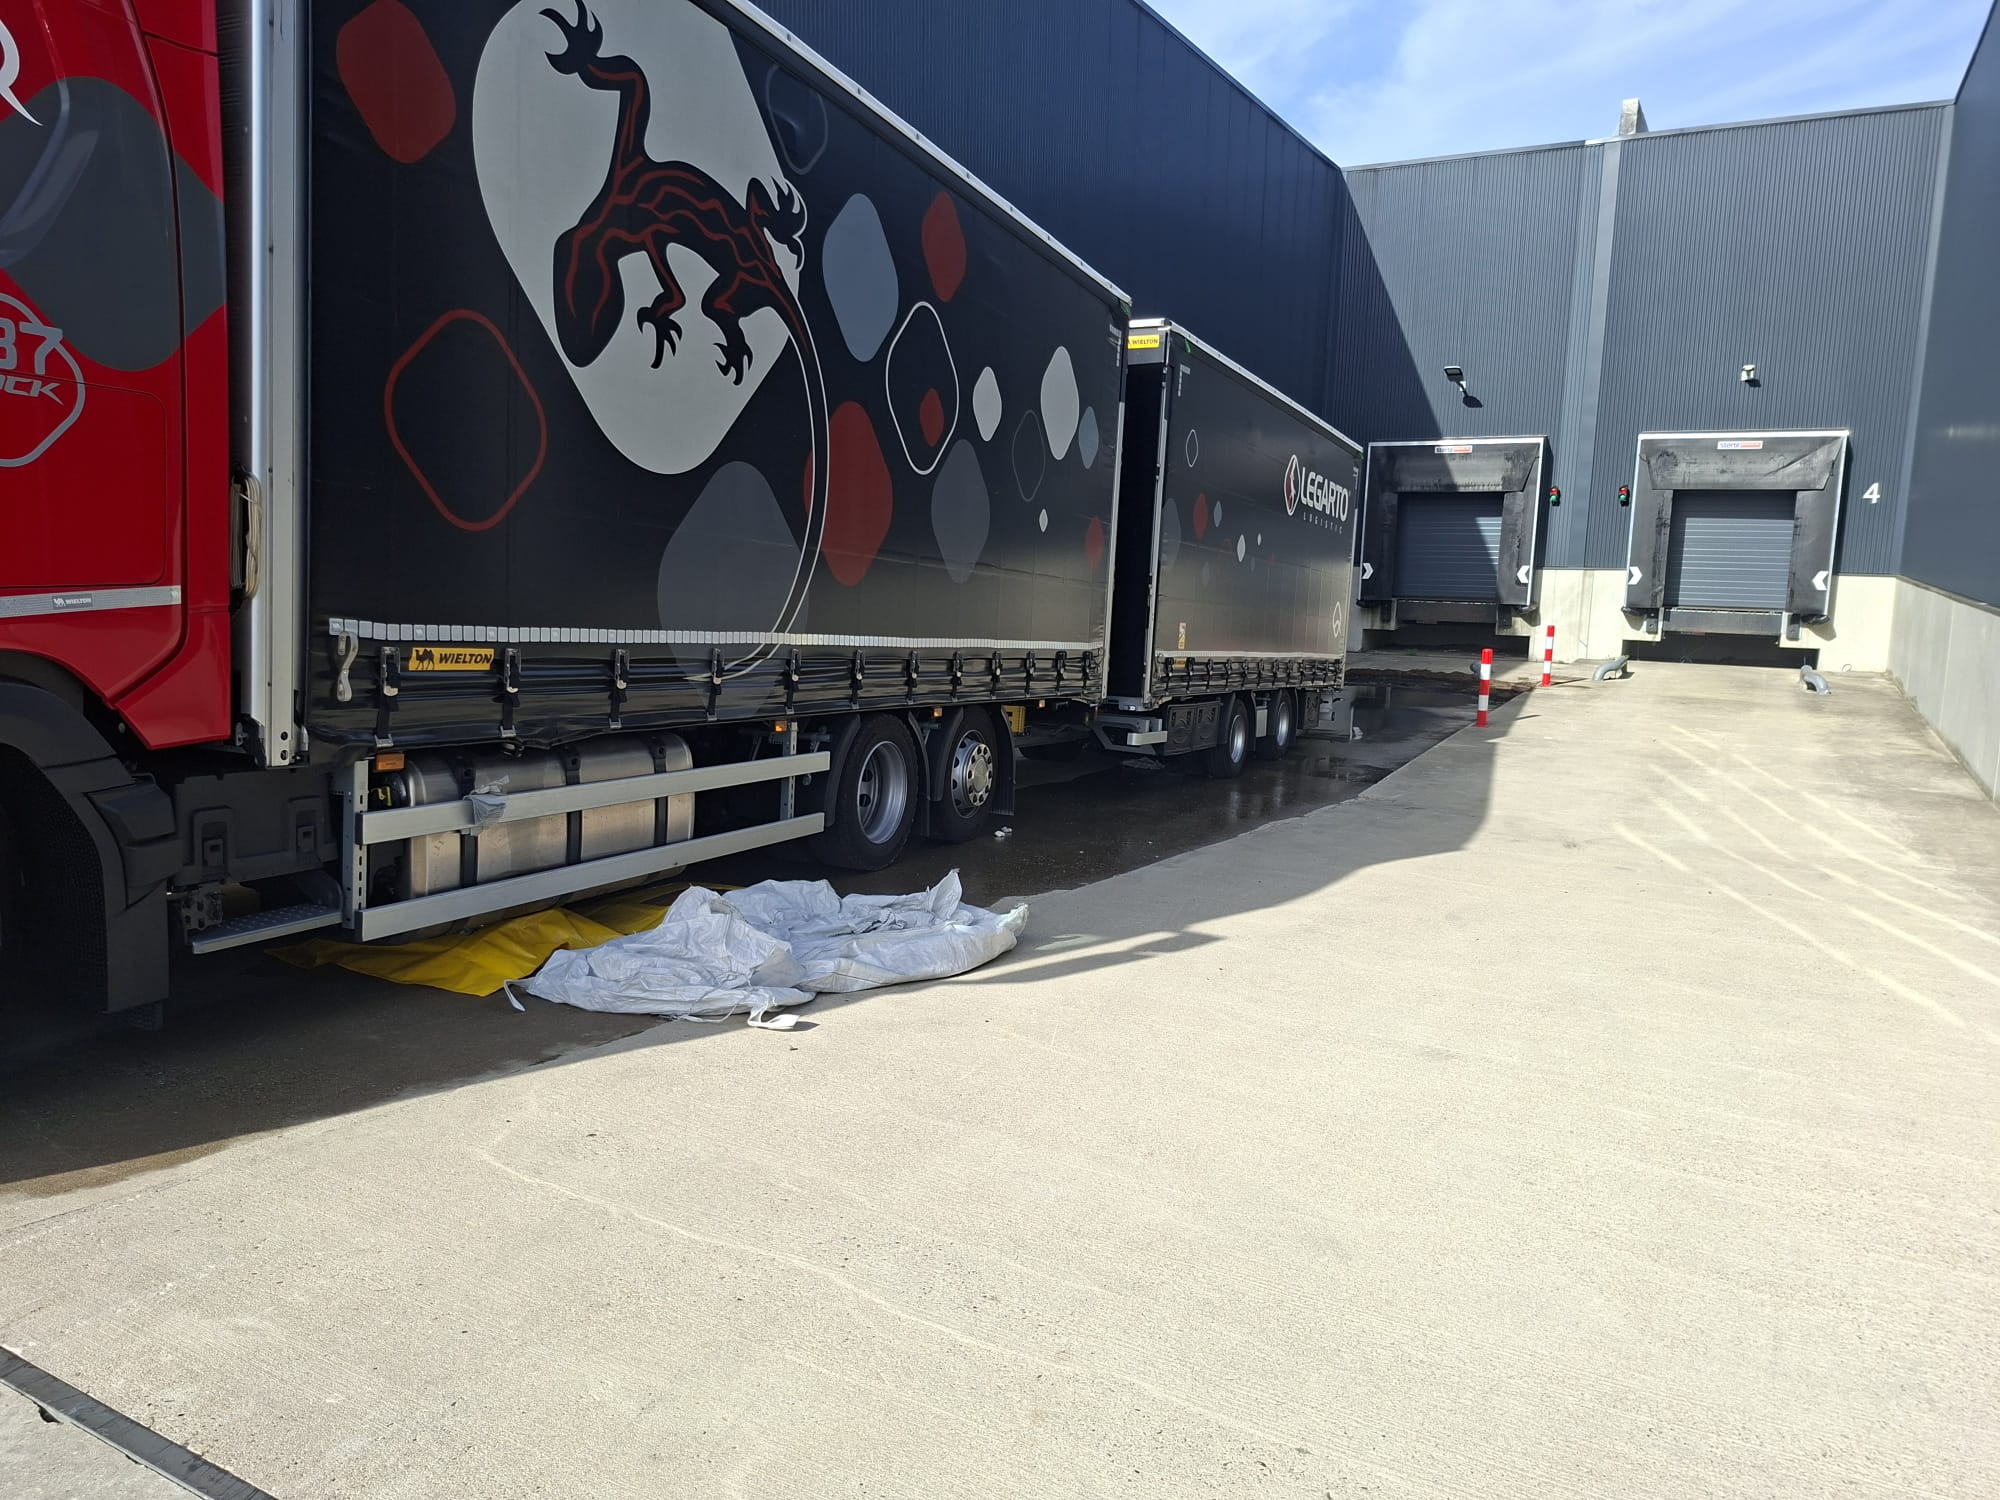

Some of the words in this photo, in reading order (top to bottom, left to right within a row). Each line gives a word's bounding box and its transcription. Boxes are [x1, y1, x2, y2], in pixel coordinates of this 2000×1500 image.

[1300, 466, 1349, 522] LEGARTO
[1863, 482, 1881, 504] 4
[438, 652, 493, 664] WIELTON
